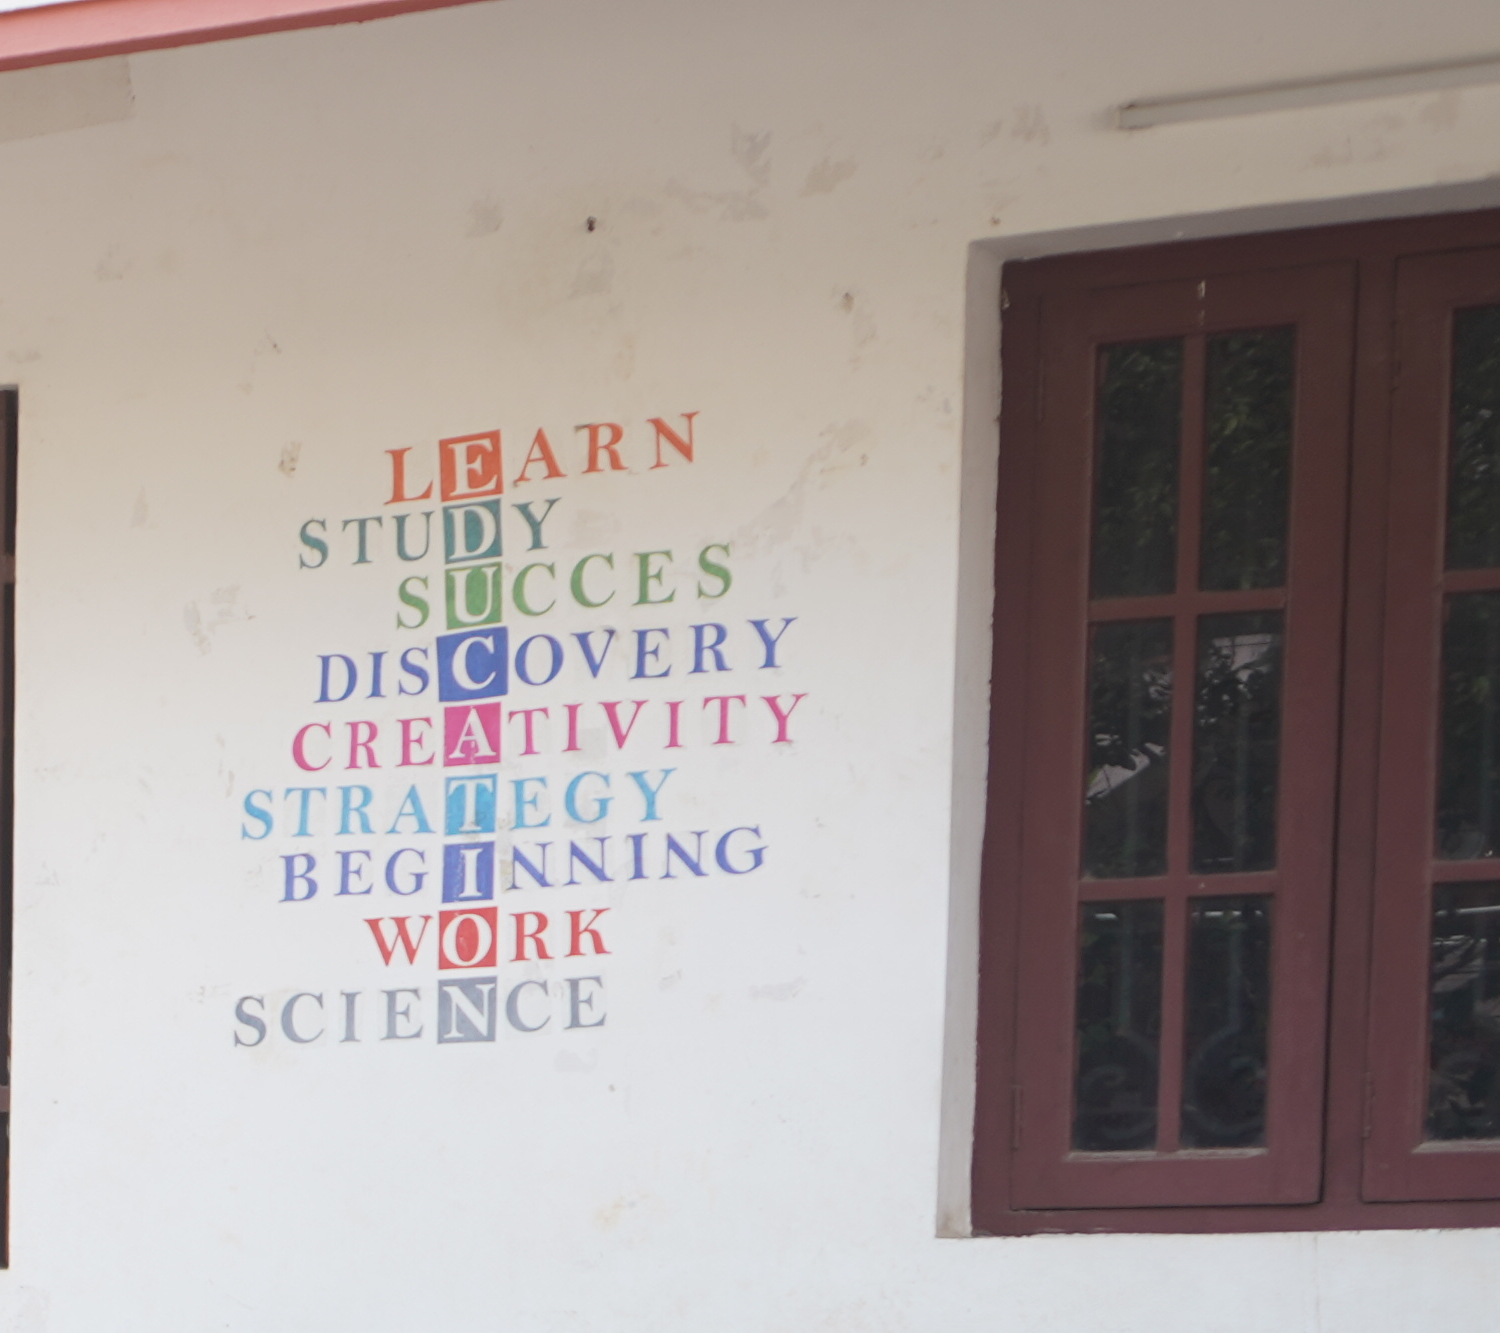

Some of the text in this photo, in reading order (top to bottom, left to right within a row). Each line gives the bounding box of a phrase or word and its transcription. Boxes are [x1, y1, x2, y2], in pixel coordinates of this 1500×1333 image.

[383, 411, 700, 505] LEARN
[298, 497, 561, 569] STUDY
[396, 543, 733, 630] SUCCES
[314, 616, 798, 703] DISCOVERY
[292, 693, 808, 771] CREATIVITY
[240, 768, 677, 840] STRATEGY
[279, 827, 768, 903] BEGINNING
[364, 906, 612, 969] WORK
[232, 976, 607, 1047] SCIENCE
